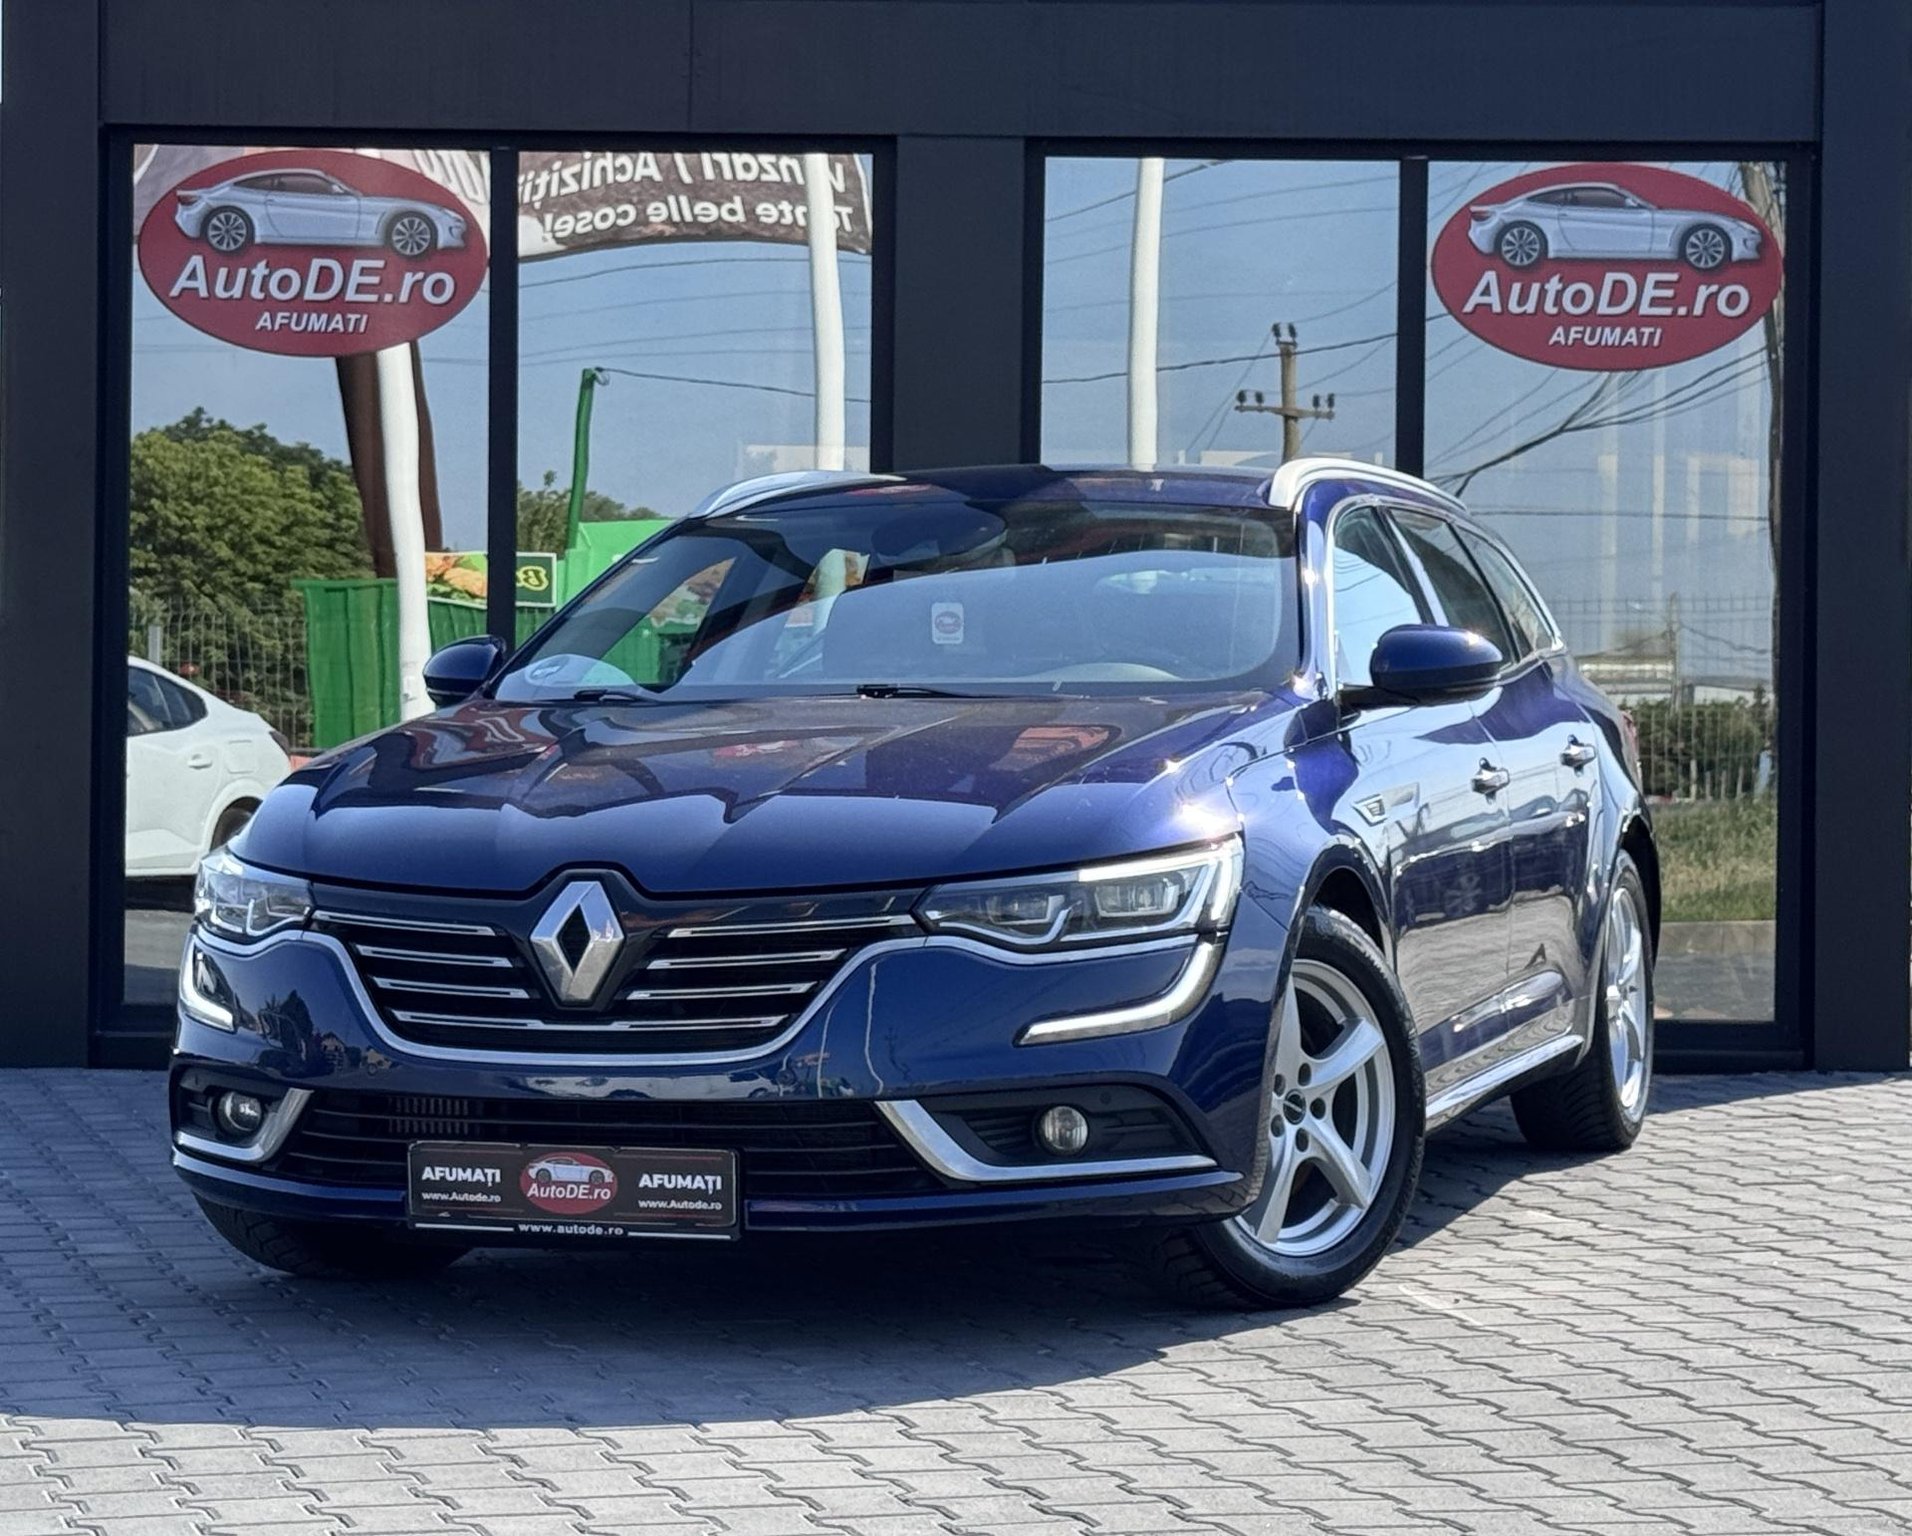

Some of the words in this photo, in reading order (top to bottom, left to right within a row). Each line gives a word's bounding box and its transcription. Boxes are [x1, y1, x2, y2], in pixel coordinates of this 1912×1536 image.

[169, 254, 456, 305] AutoDE.ro
[1462, 270, 1750, 318] AutoDE.ro
[255, 311, 369, 333] AFUMATI
[1549, 326, 1662, 347] AFUMATI
[421, 1191, 502, 1203] www.Autode.ro
[527, 1183, 611, 1200] AutoDE.ro
[638, 1199, 723, 1211] www.Autode.ro
[518, 1224, 624, 1236] www.autode.ro
